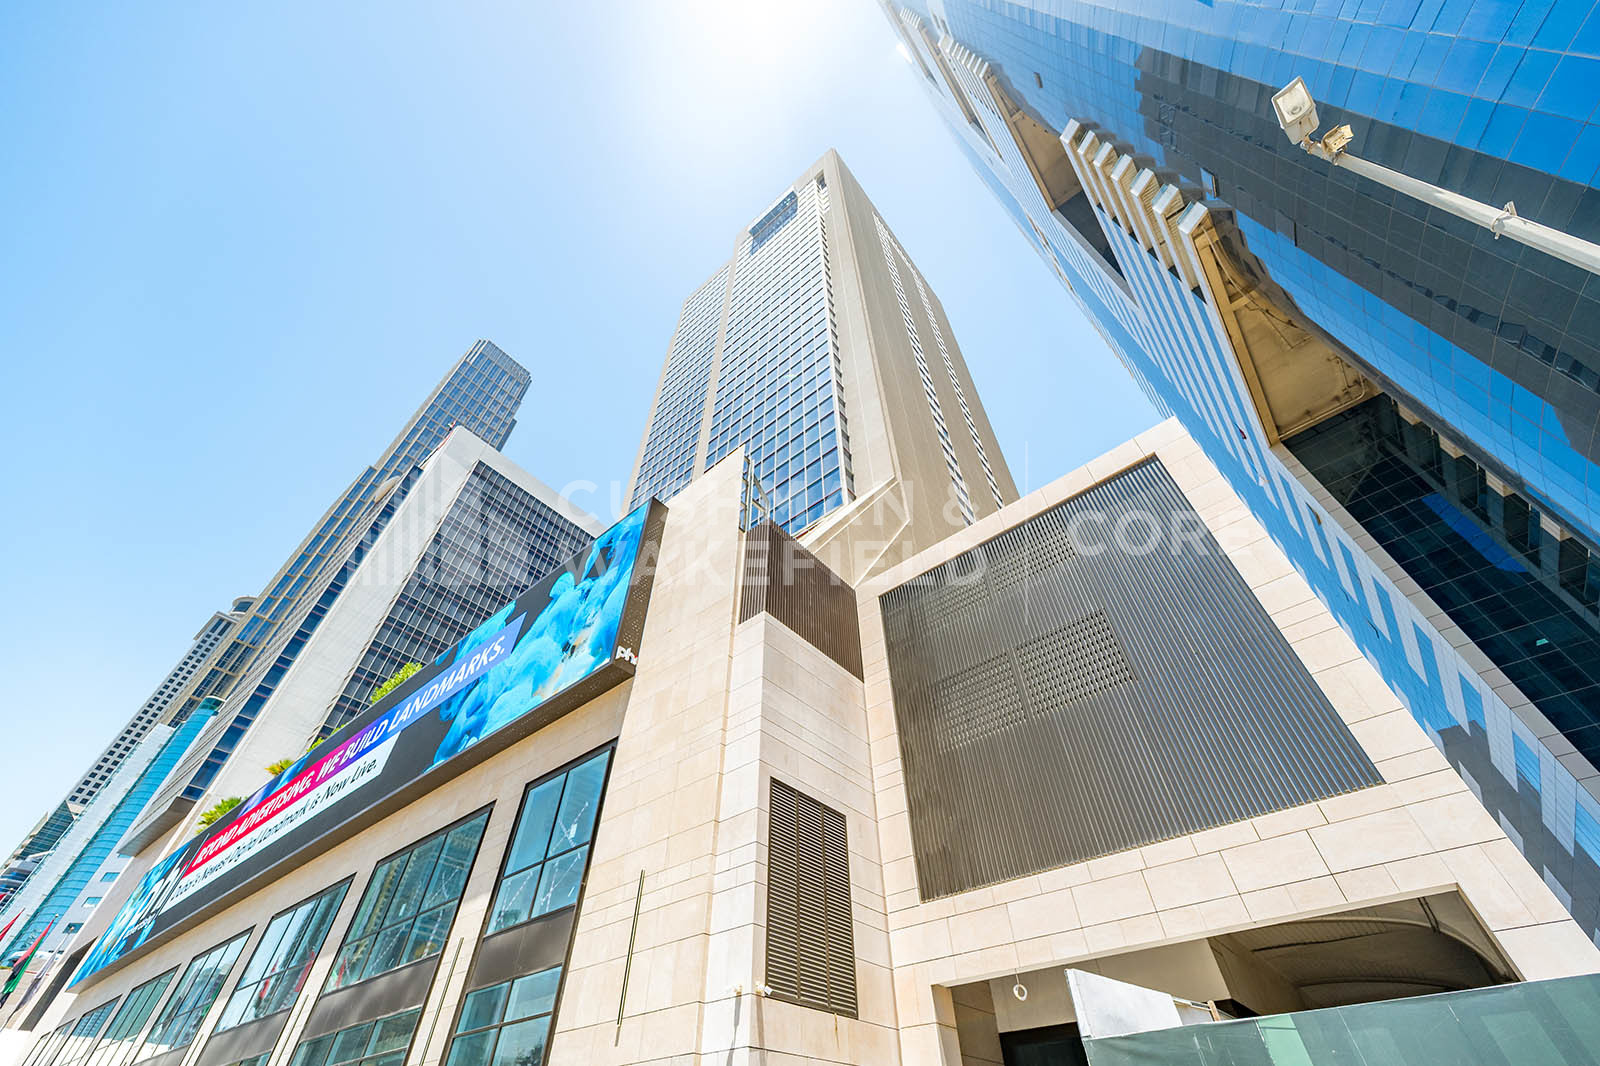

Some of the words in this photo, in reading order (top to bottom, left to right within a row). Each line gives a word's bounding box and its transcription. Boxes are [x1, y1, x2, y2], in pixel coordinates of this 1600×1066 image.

[192, 825, 238, 868] BEYOND
[237, 771, 315, 836] ADVERTISING.
[316, 750, 344, 782] WE
[340, 719, 389, 766] BUILD
[387, 636, 505, 733] LANDMARKS.
[258, 799, 311, 844] Landmark
[308, 792, 321, 811] is
[320, 777, 350, 803] Now
[351, 757, 377, 783] Live.
